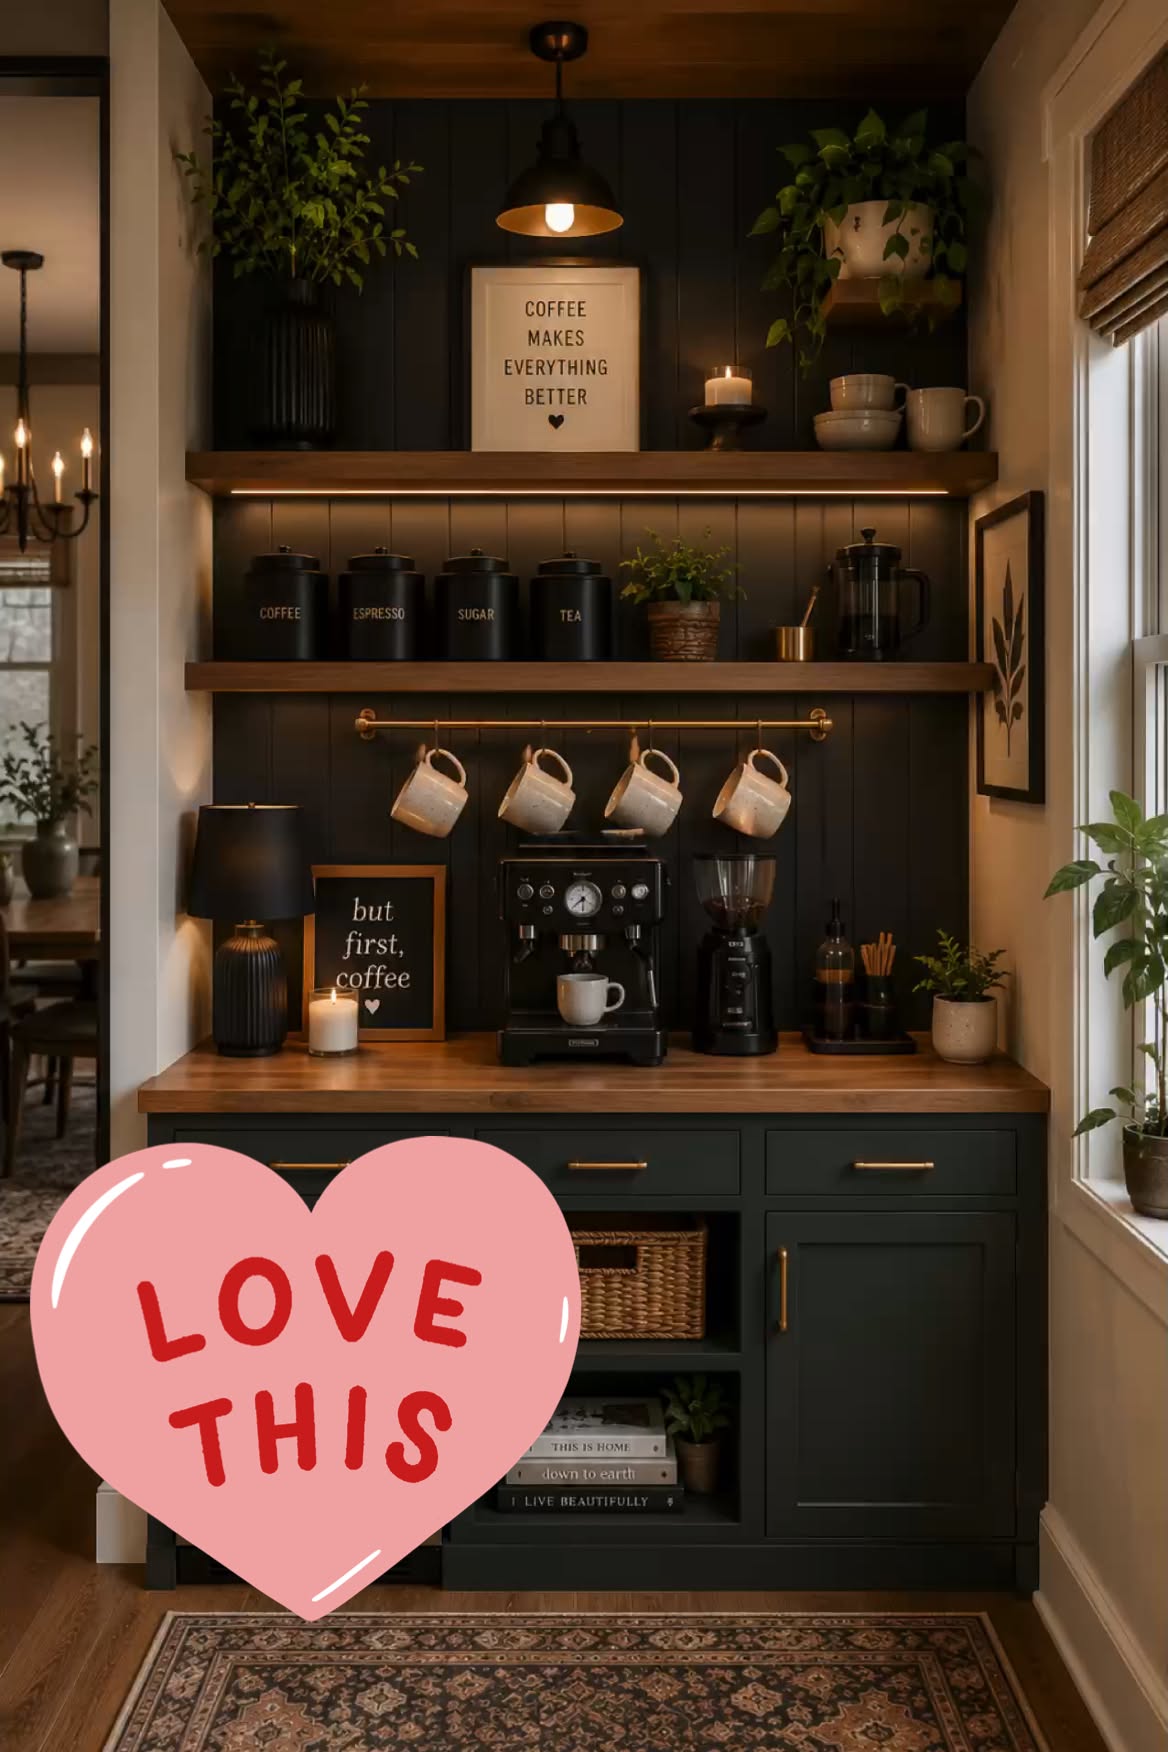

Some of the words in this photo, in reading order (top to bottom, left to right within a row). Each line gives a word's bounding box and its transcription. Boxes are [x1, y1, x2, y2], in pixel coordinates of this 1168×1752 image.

[524, 300, 587, 318] COFFEE
[527, 329, 585, 347] MAKES
[504, 358, 608, 376] EVERYTHING
[524, 387, 588, 406] BETTER
[259, 606, 302, 621] COFFEE
[352, 606, 406, 621] ESPRESSO
[457, 607, 496, 622] SUGAR
[559, 608, 583, 623] TEA
[352, 896, 395, 922] but
[341, 930, 405, 960] first,
[335, 964, 411, 989] coffee
[551, 1442, 579, 1453] THIS
[582, 1442, 593, 1453] IS
[597, 1442, 631, 1453] HOME
[542, 1467, 579, 1481] down
[583, 1469, 597, 1481] to
[600, 1467, 636, 1481] earth
[524, 1496, 555, 1508] LIVE
[560, 1496, 649, 1508] BEAUTIFULLY
